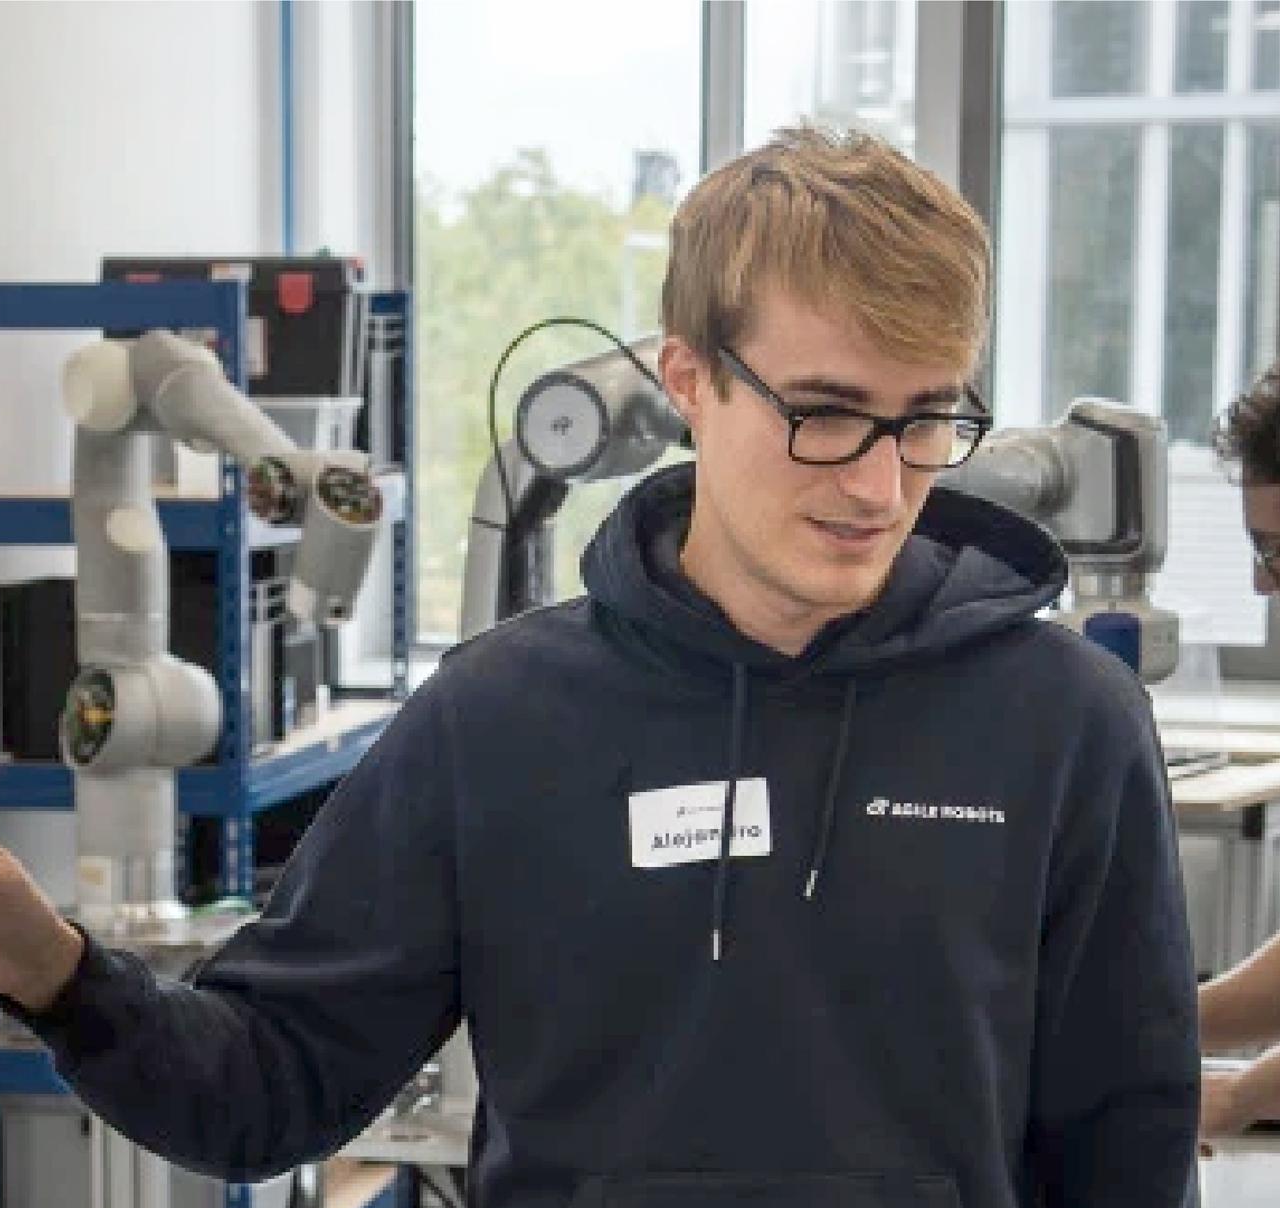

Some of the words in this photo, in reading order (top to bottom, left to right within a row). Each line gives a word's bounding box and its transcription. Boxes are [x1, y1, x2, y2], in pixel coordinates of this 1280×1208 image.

[891, 801, 938, 817] AGILE
[941, 804, 1006, 822] ROBOTS
[651, 824, 762, 850] Alejanro
